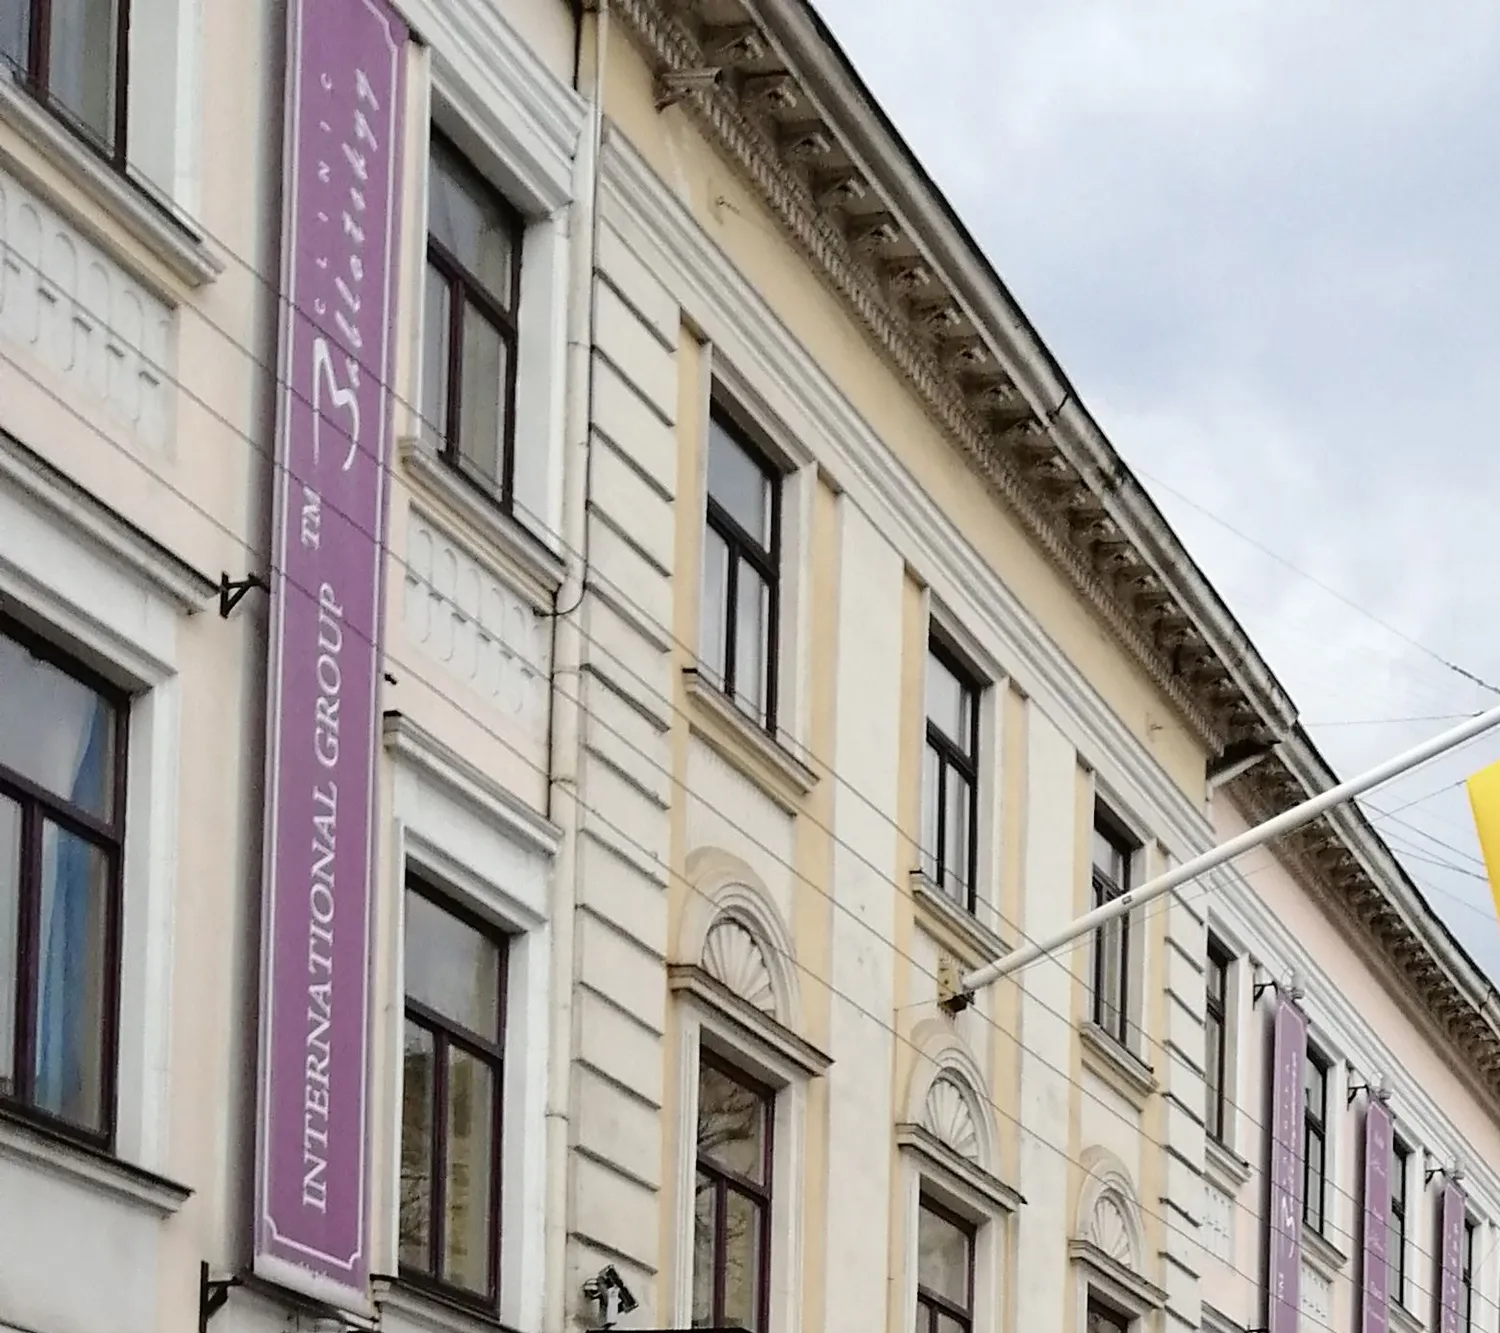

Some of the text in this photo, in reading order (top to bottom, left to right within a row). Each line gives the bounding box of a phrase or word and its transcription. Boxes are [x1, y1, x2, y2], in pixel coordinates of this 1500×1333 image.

[313, 72, 333, 316] CLINIC
[301, 489, 344, 1214] INTERNATIONAL GROUP TM
